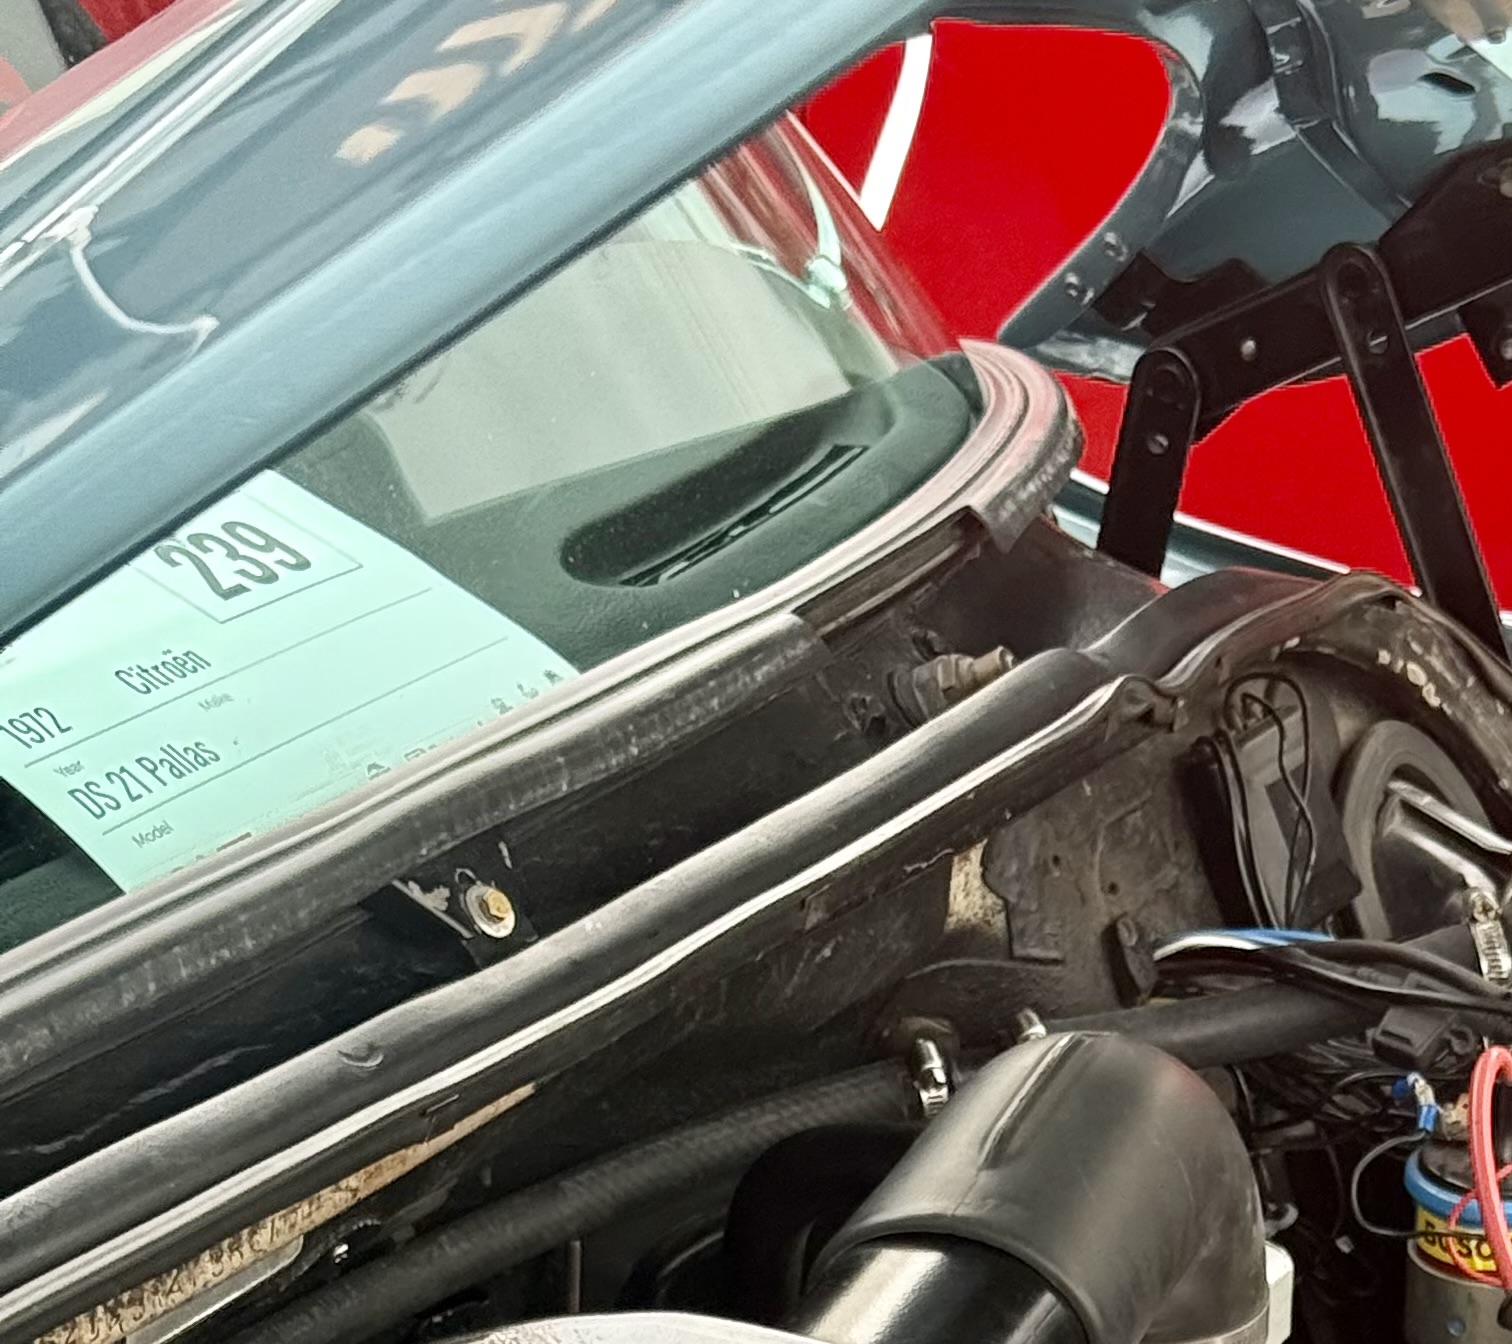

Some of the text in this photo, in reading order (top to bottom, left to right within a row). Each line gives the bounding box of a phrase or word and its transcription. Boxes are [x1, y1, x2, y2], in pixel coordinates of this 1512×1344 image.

[156, 520, 312, 601] 239
[114, 648, 212, 697] Citroën
[0, 706, 74, 750] 1972
[66, 736, 221, 822] DS 21 Pallas
[131, 819, 176, 849] Model
